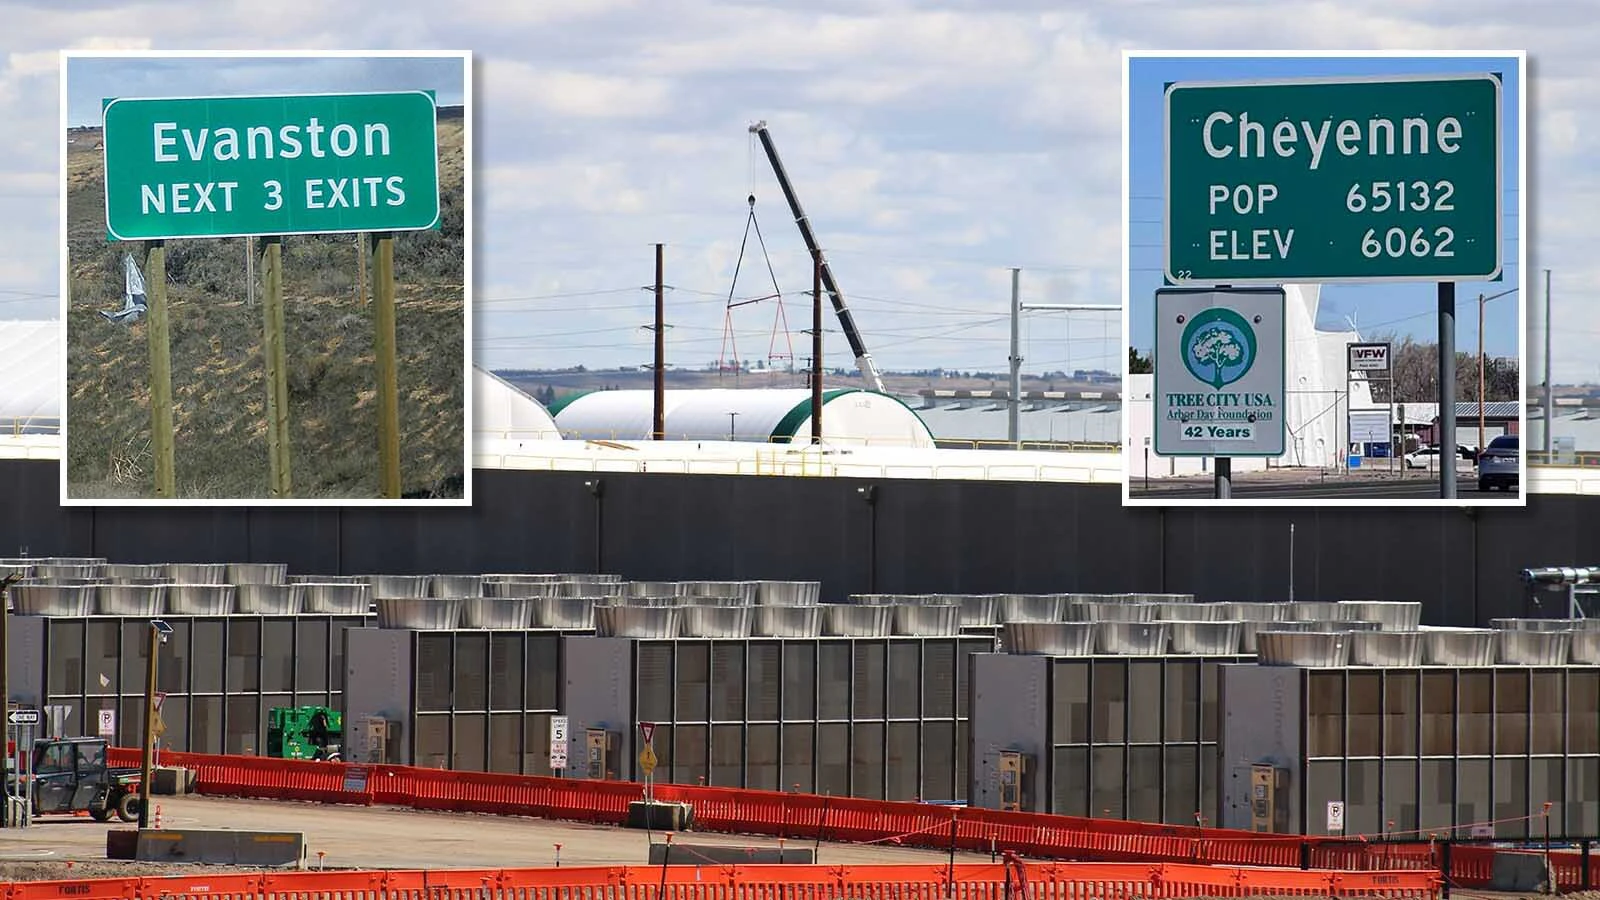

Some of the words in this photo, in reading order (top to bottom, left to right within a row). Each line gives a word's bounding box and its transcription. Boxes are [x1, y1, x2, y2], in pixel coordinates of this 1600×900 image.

[153, 118, 390, 162] Evanston
[1202, 111, 1463, 169] Cheyenne
[141, 182, 238, 214] NEXT
[263, 180, 282, 211] 3
[306, 176, 406, 208] EXITS
[1209, 184, 1278, 215] POP
[1346, 180, 1455, 213] 65132
[1210, 229, 1294, 260] ELEV
[1361, 226, 1455, 258] 6062
[1178, 270, 1192, 280] 22
[1356, 349, 1386, 358] VFW
[1166, 393, 1204, 406] TREE
[1207, 393, 1240, 406] CITY
[1245, 393, 1273, 406] USA
[1167, 409, 1194, 419] Arbor
[1197, 409, 1215, 421] Day
[1218, 408, 1273, 419] Foundation
[1184, 426, 1203, 438] 42
[1208, 426, 1250, 438] Years
[556, 730, 563, 739] 5
